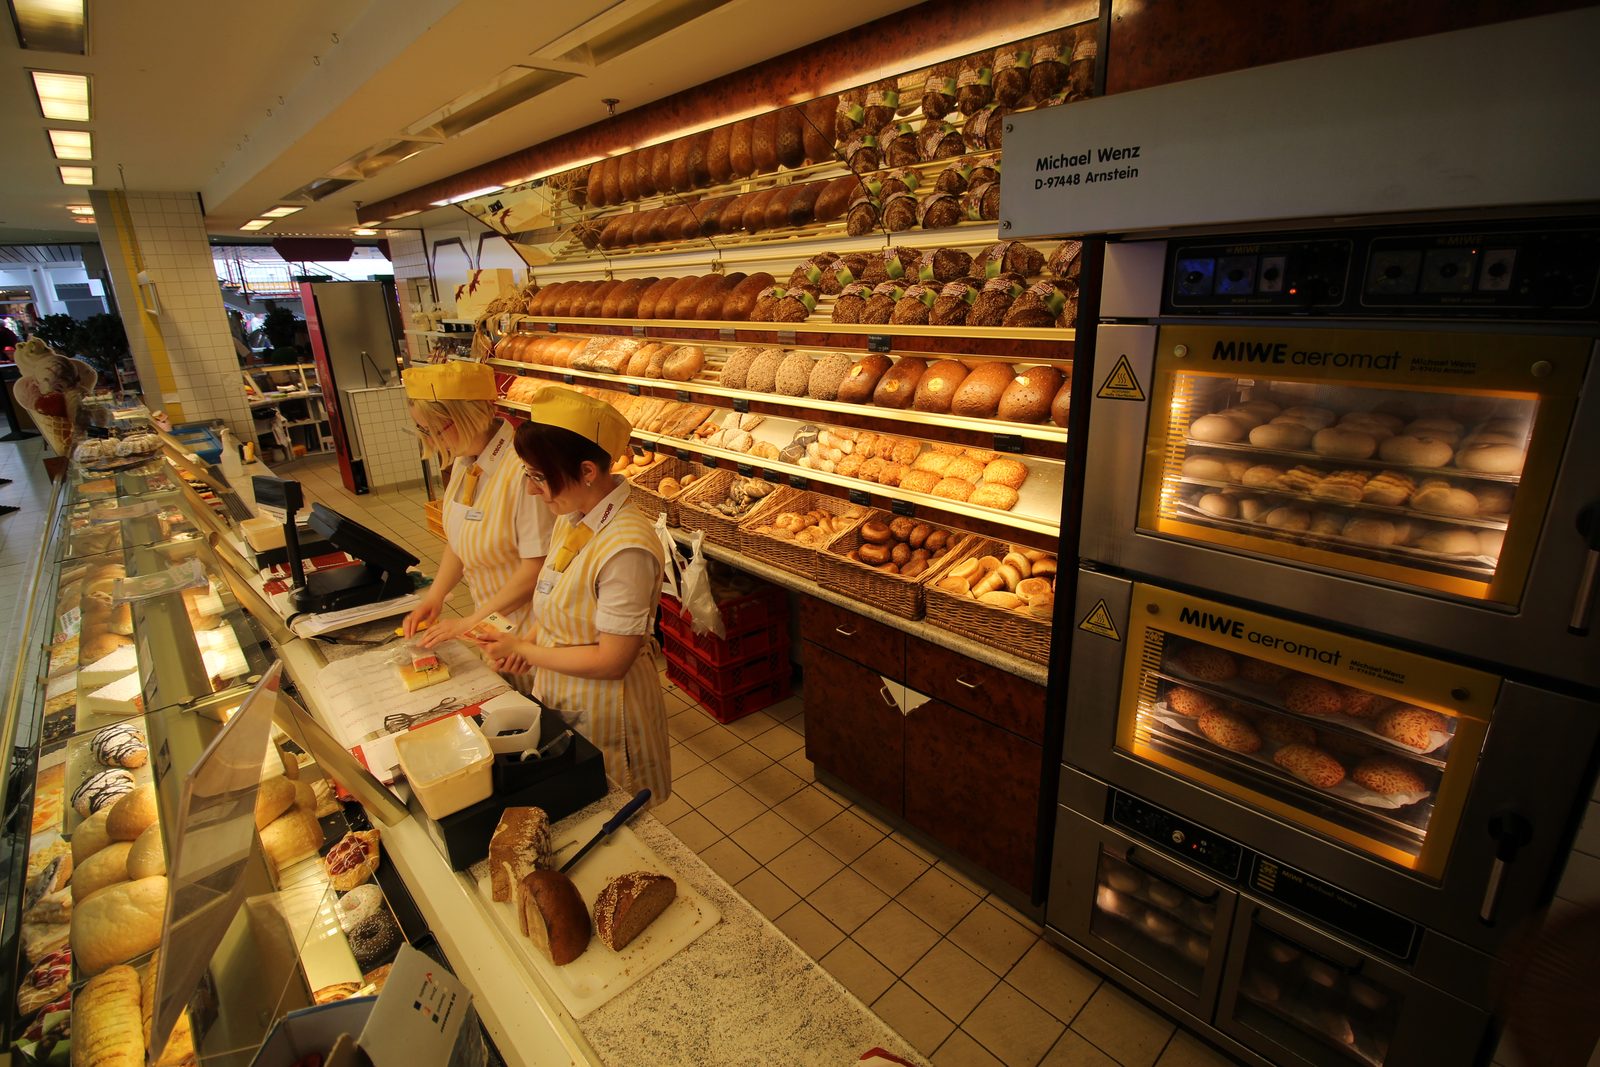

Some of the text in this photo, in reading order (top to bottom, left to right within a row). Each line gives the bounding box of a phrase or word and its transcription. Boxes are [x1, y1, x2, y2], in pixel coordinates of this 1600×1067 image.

[1036, 146, 1140, 172] Michael Wenz
[1035, 166, 1139, 190] D-97448 Arnstein
[1212, 340, 1401, 370] MIWE aeromat
[1179, 607, 1342, 666] MIWE aeromat
